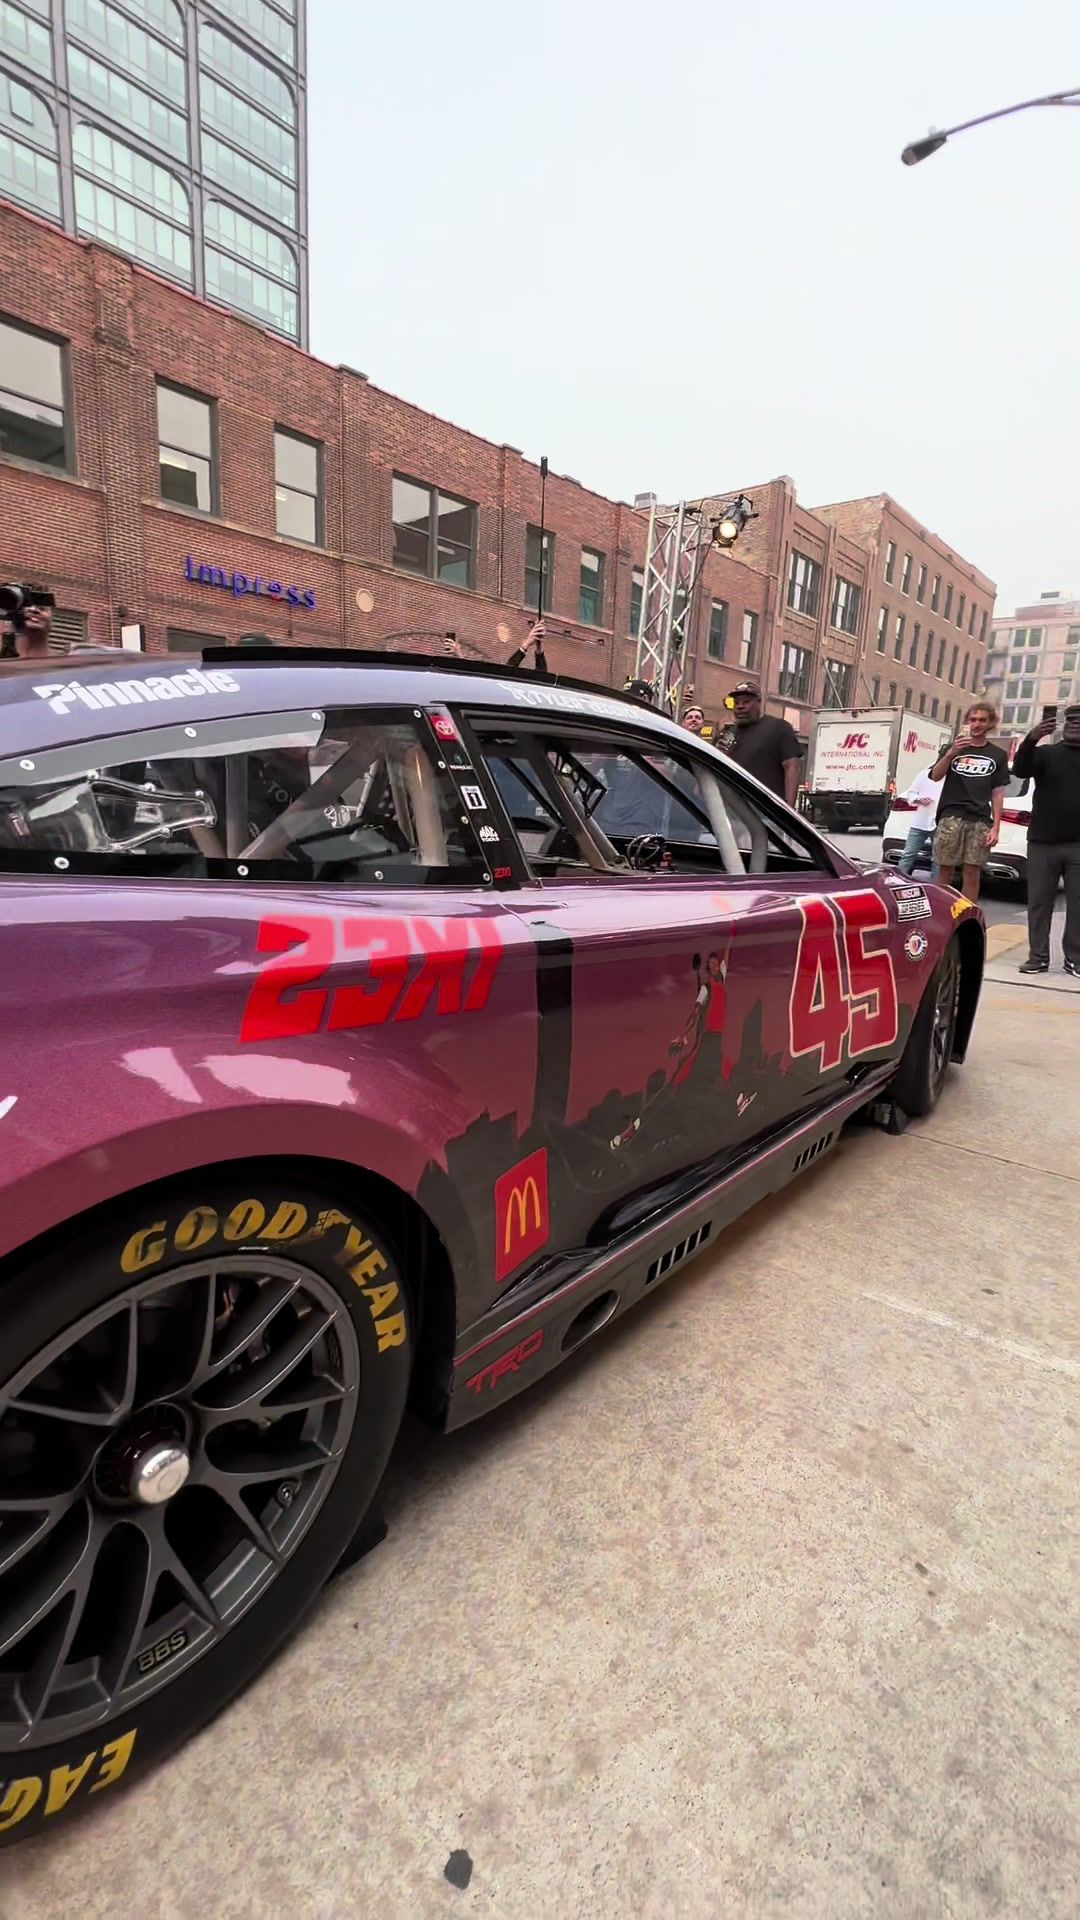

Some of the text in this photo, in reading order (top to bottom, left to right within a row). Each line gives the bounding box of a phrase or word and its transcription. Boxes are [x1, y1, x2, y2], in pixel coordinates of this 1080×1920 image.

[32, 668, 240, 715] Pinnacle
[837, 732, 870, 749] JFC
[825, 763, 876, 772] www.jfc.com
[956, 762, 990, 774] 2000
[240, 914, 504, 1043] 23XI
[789, 888, 898, 1073] 45
[466, 1329, 544, 1394] TRD
[138, 1629, 186, 1671] BBS
